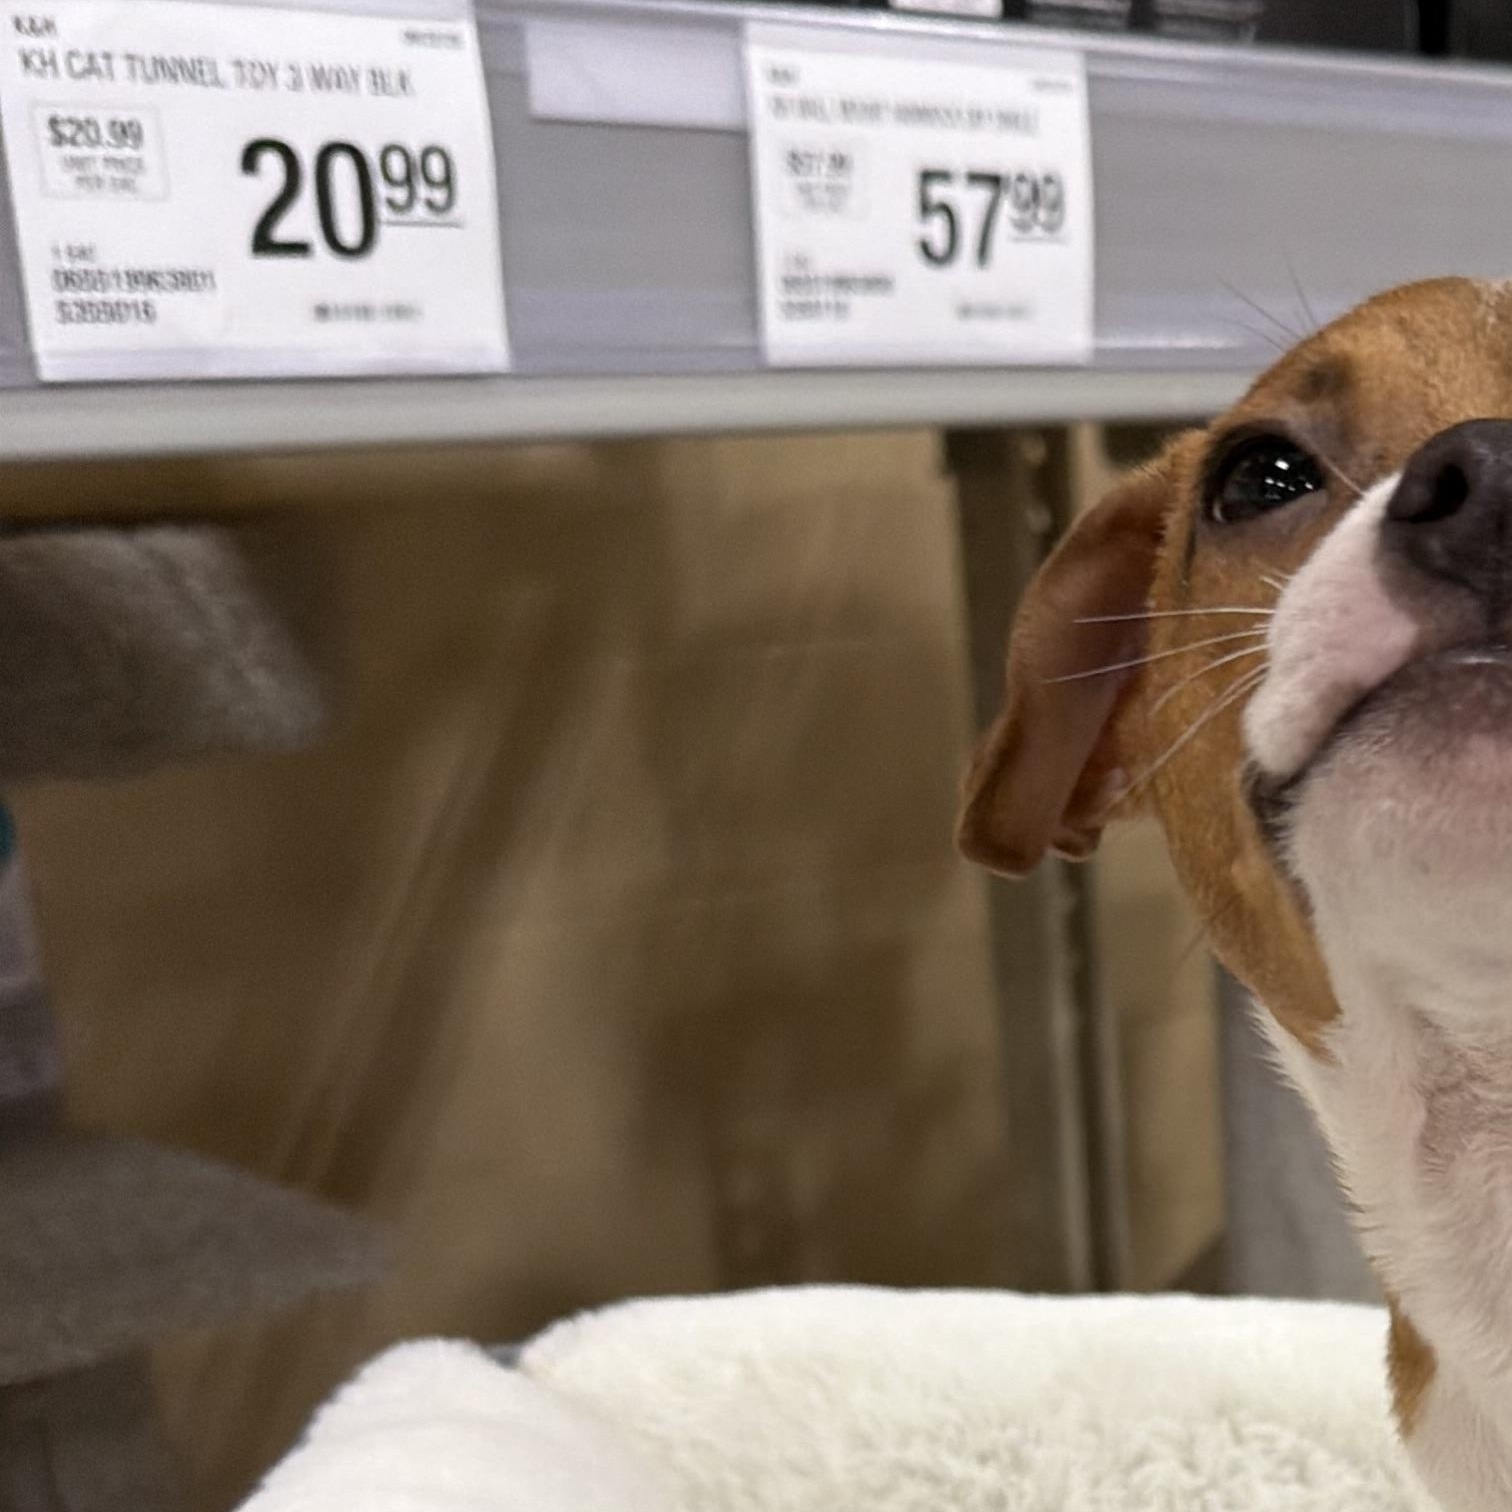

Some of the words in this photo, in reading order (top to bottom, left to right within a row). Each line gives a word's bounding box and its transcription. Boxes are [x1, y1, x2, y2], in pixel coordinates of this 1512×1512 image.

[66, 50, 115, 82] CAT
[124, 54, 225, 89] TUNNEL
[232, 59, 278, 91] TOY
[48, 115, 143, 150] $20.99
